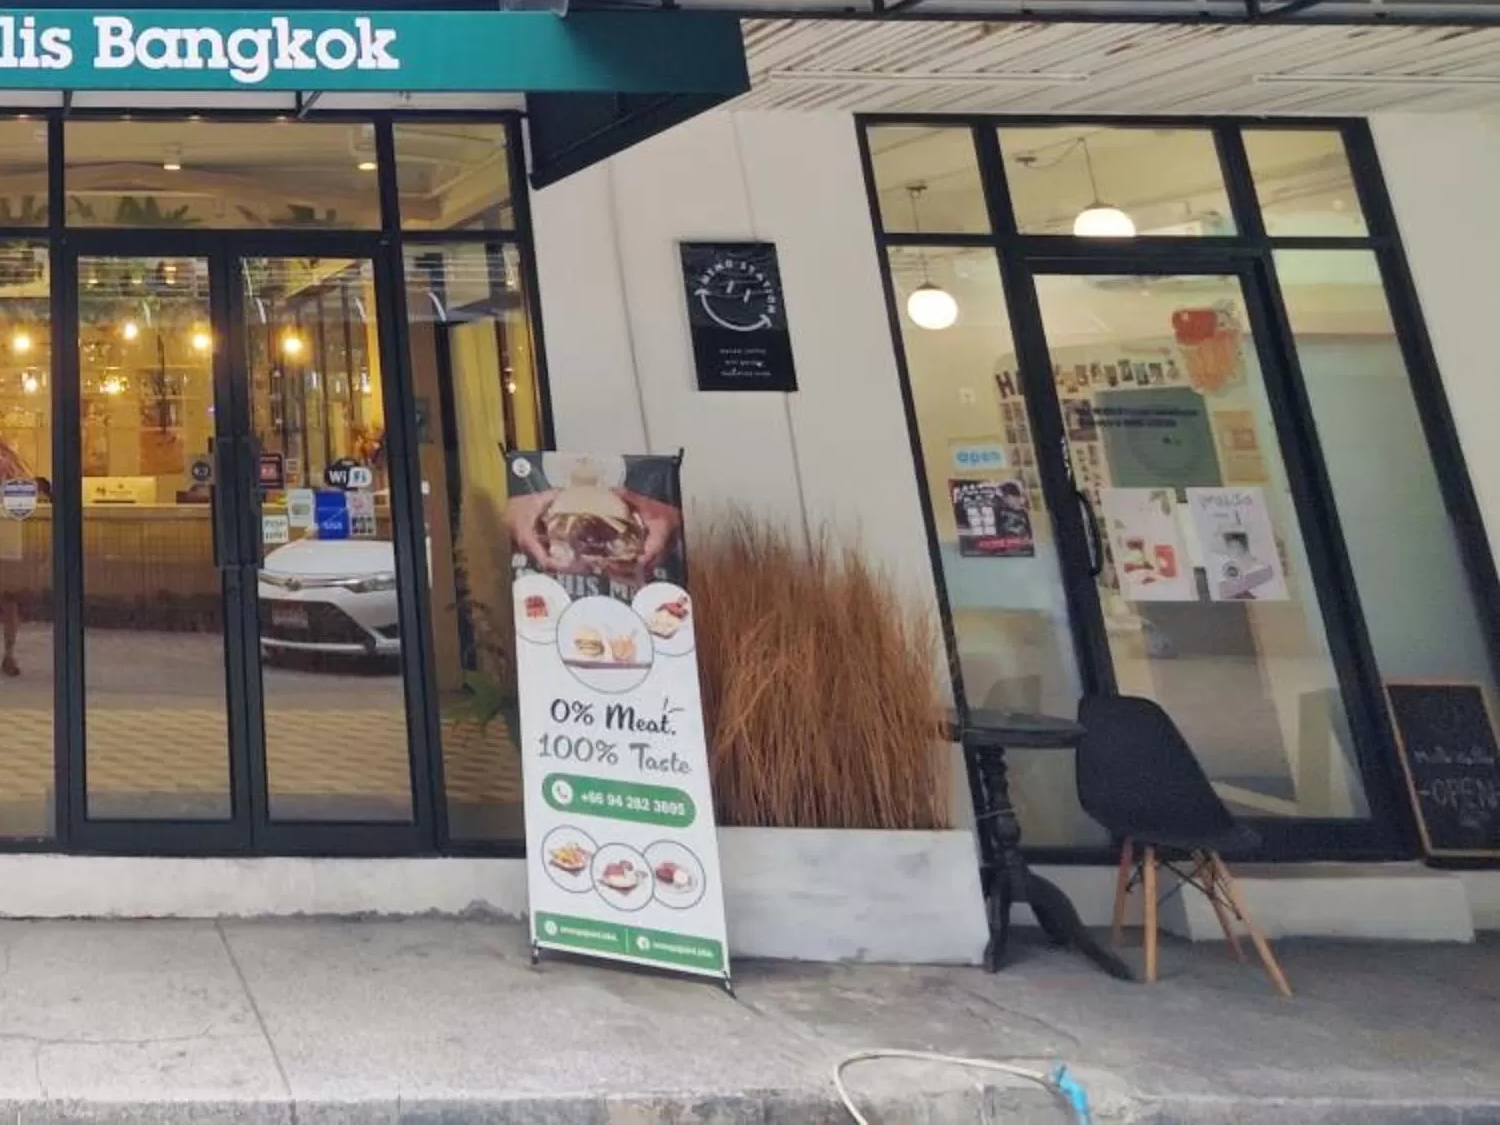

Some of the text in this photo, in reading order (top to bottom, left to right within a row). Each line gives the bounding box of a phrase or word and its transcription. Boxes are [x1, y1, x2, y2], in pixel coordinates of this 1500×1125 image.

[93, 16, 400, 83] Bangkok
[550, 698, 594, 725] 0%
[538, 732, 691, 774] 100% Taste
